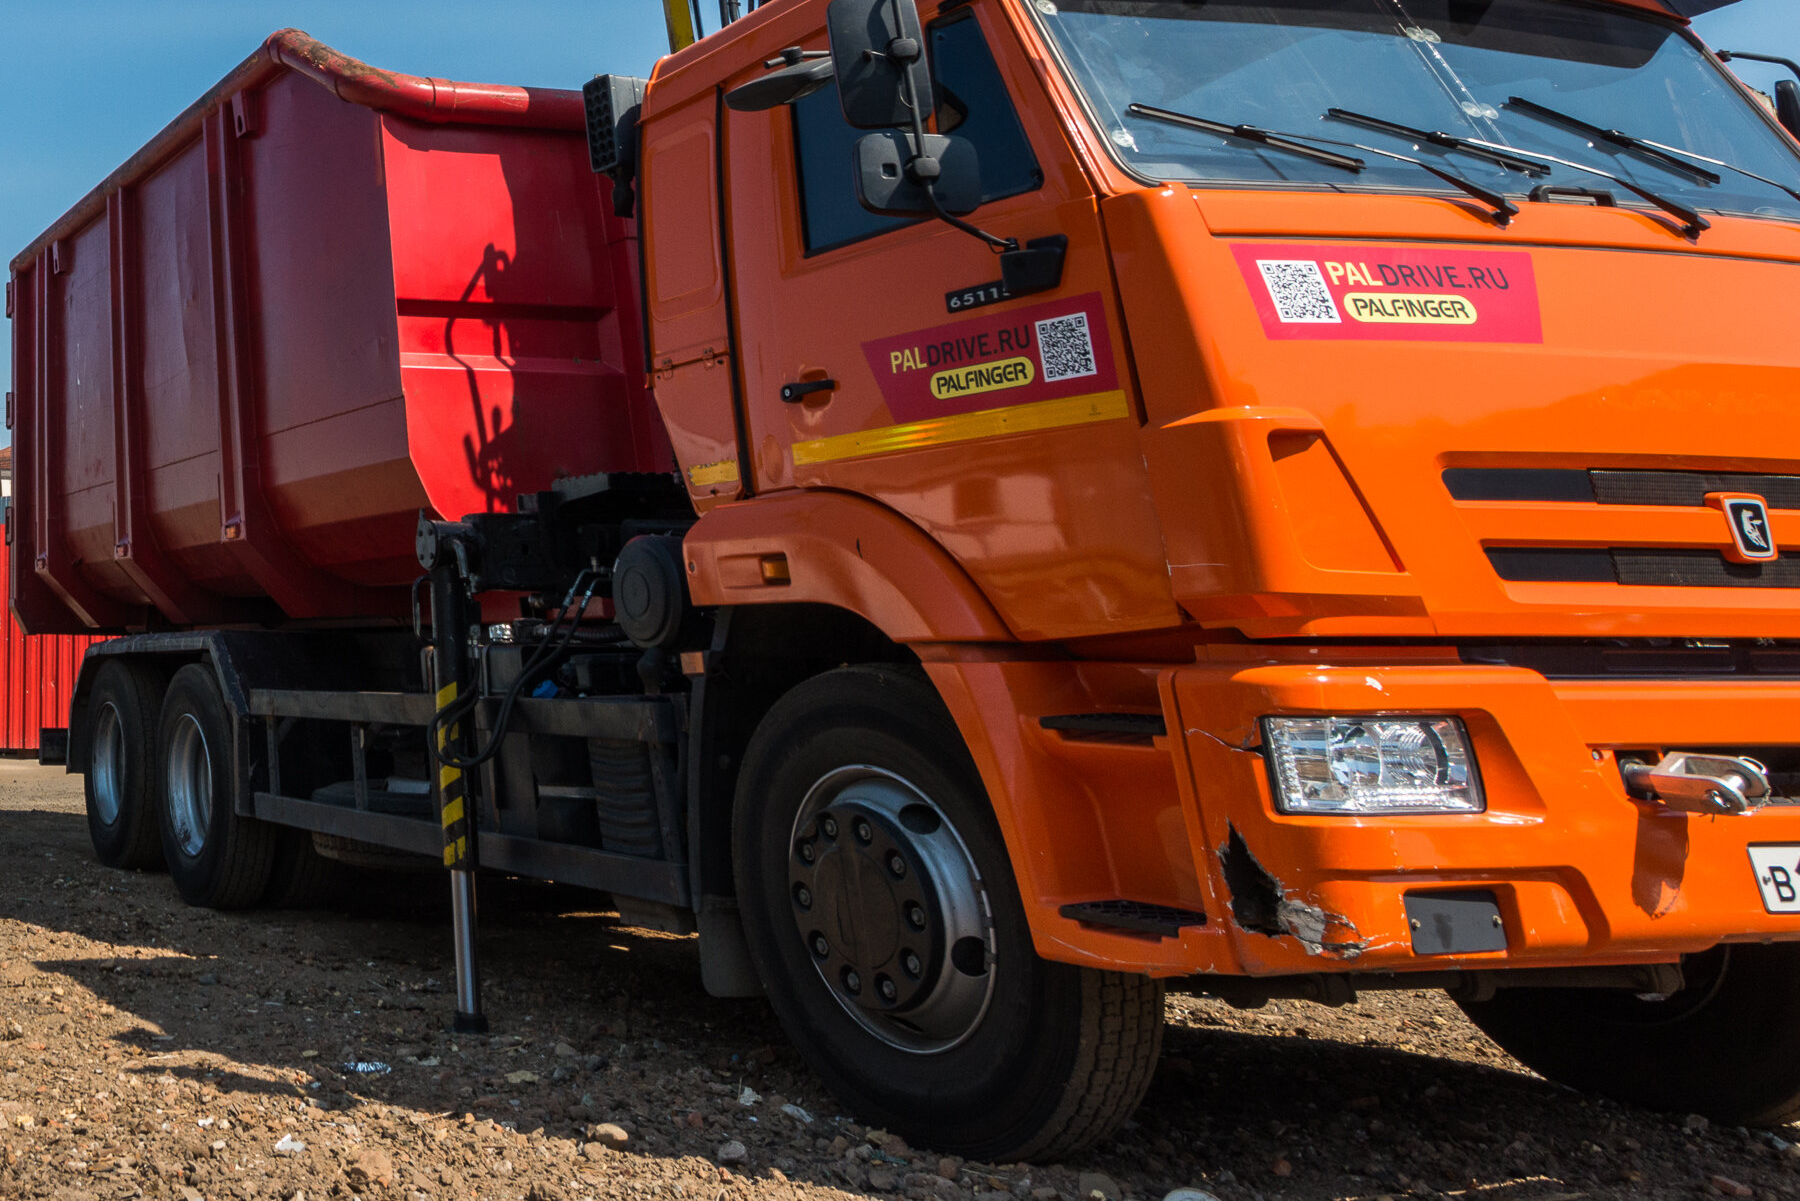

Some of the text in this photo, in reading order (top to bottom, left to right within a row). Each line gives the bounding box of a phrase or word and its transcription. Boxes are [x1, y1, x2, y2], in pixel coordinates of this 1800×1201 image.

[1324, 261, 1509, 290] PALDRIVE.RU
[1352, 298, 1470, 319] PALFINGER
[890, 324, 1031, 375] PALDRIVE.RU
[936, 362, 1028, 395] PALFINGER
[1768, 858, 1800, 902] B
